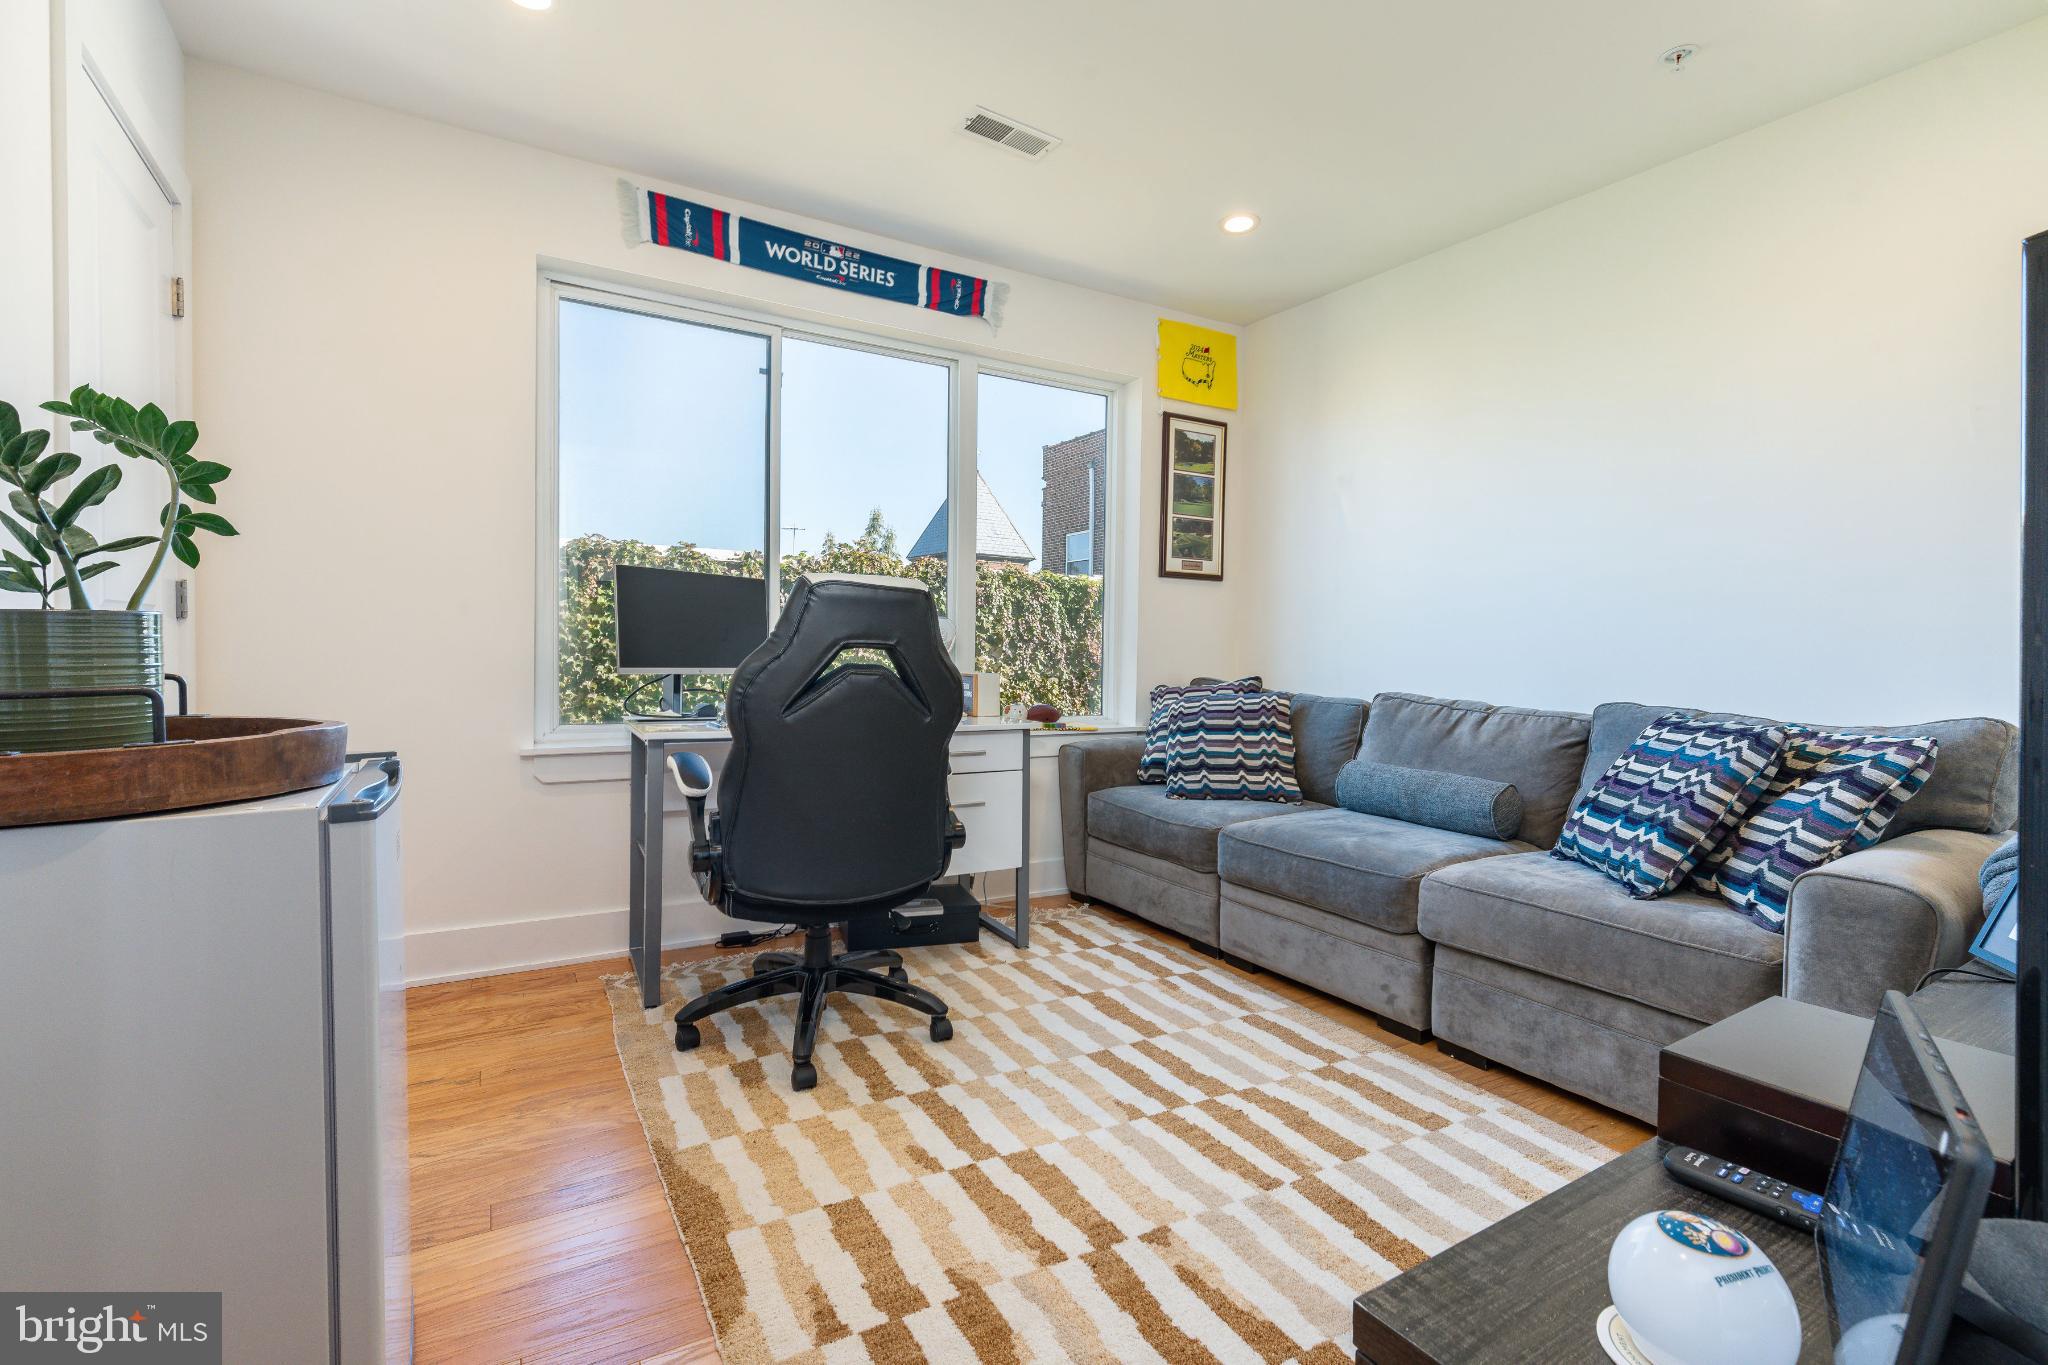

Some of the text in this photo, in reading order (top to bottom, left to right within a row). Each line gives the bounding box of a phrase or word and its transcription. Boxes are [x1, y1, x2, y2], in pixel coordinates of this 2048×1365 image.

[764, 240, 896, 288] WORLD SERIES
[1714, 1268, 1755, 1287] PRESIDENT
